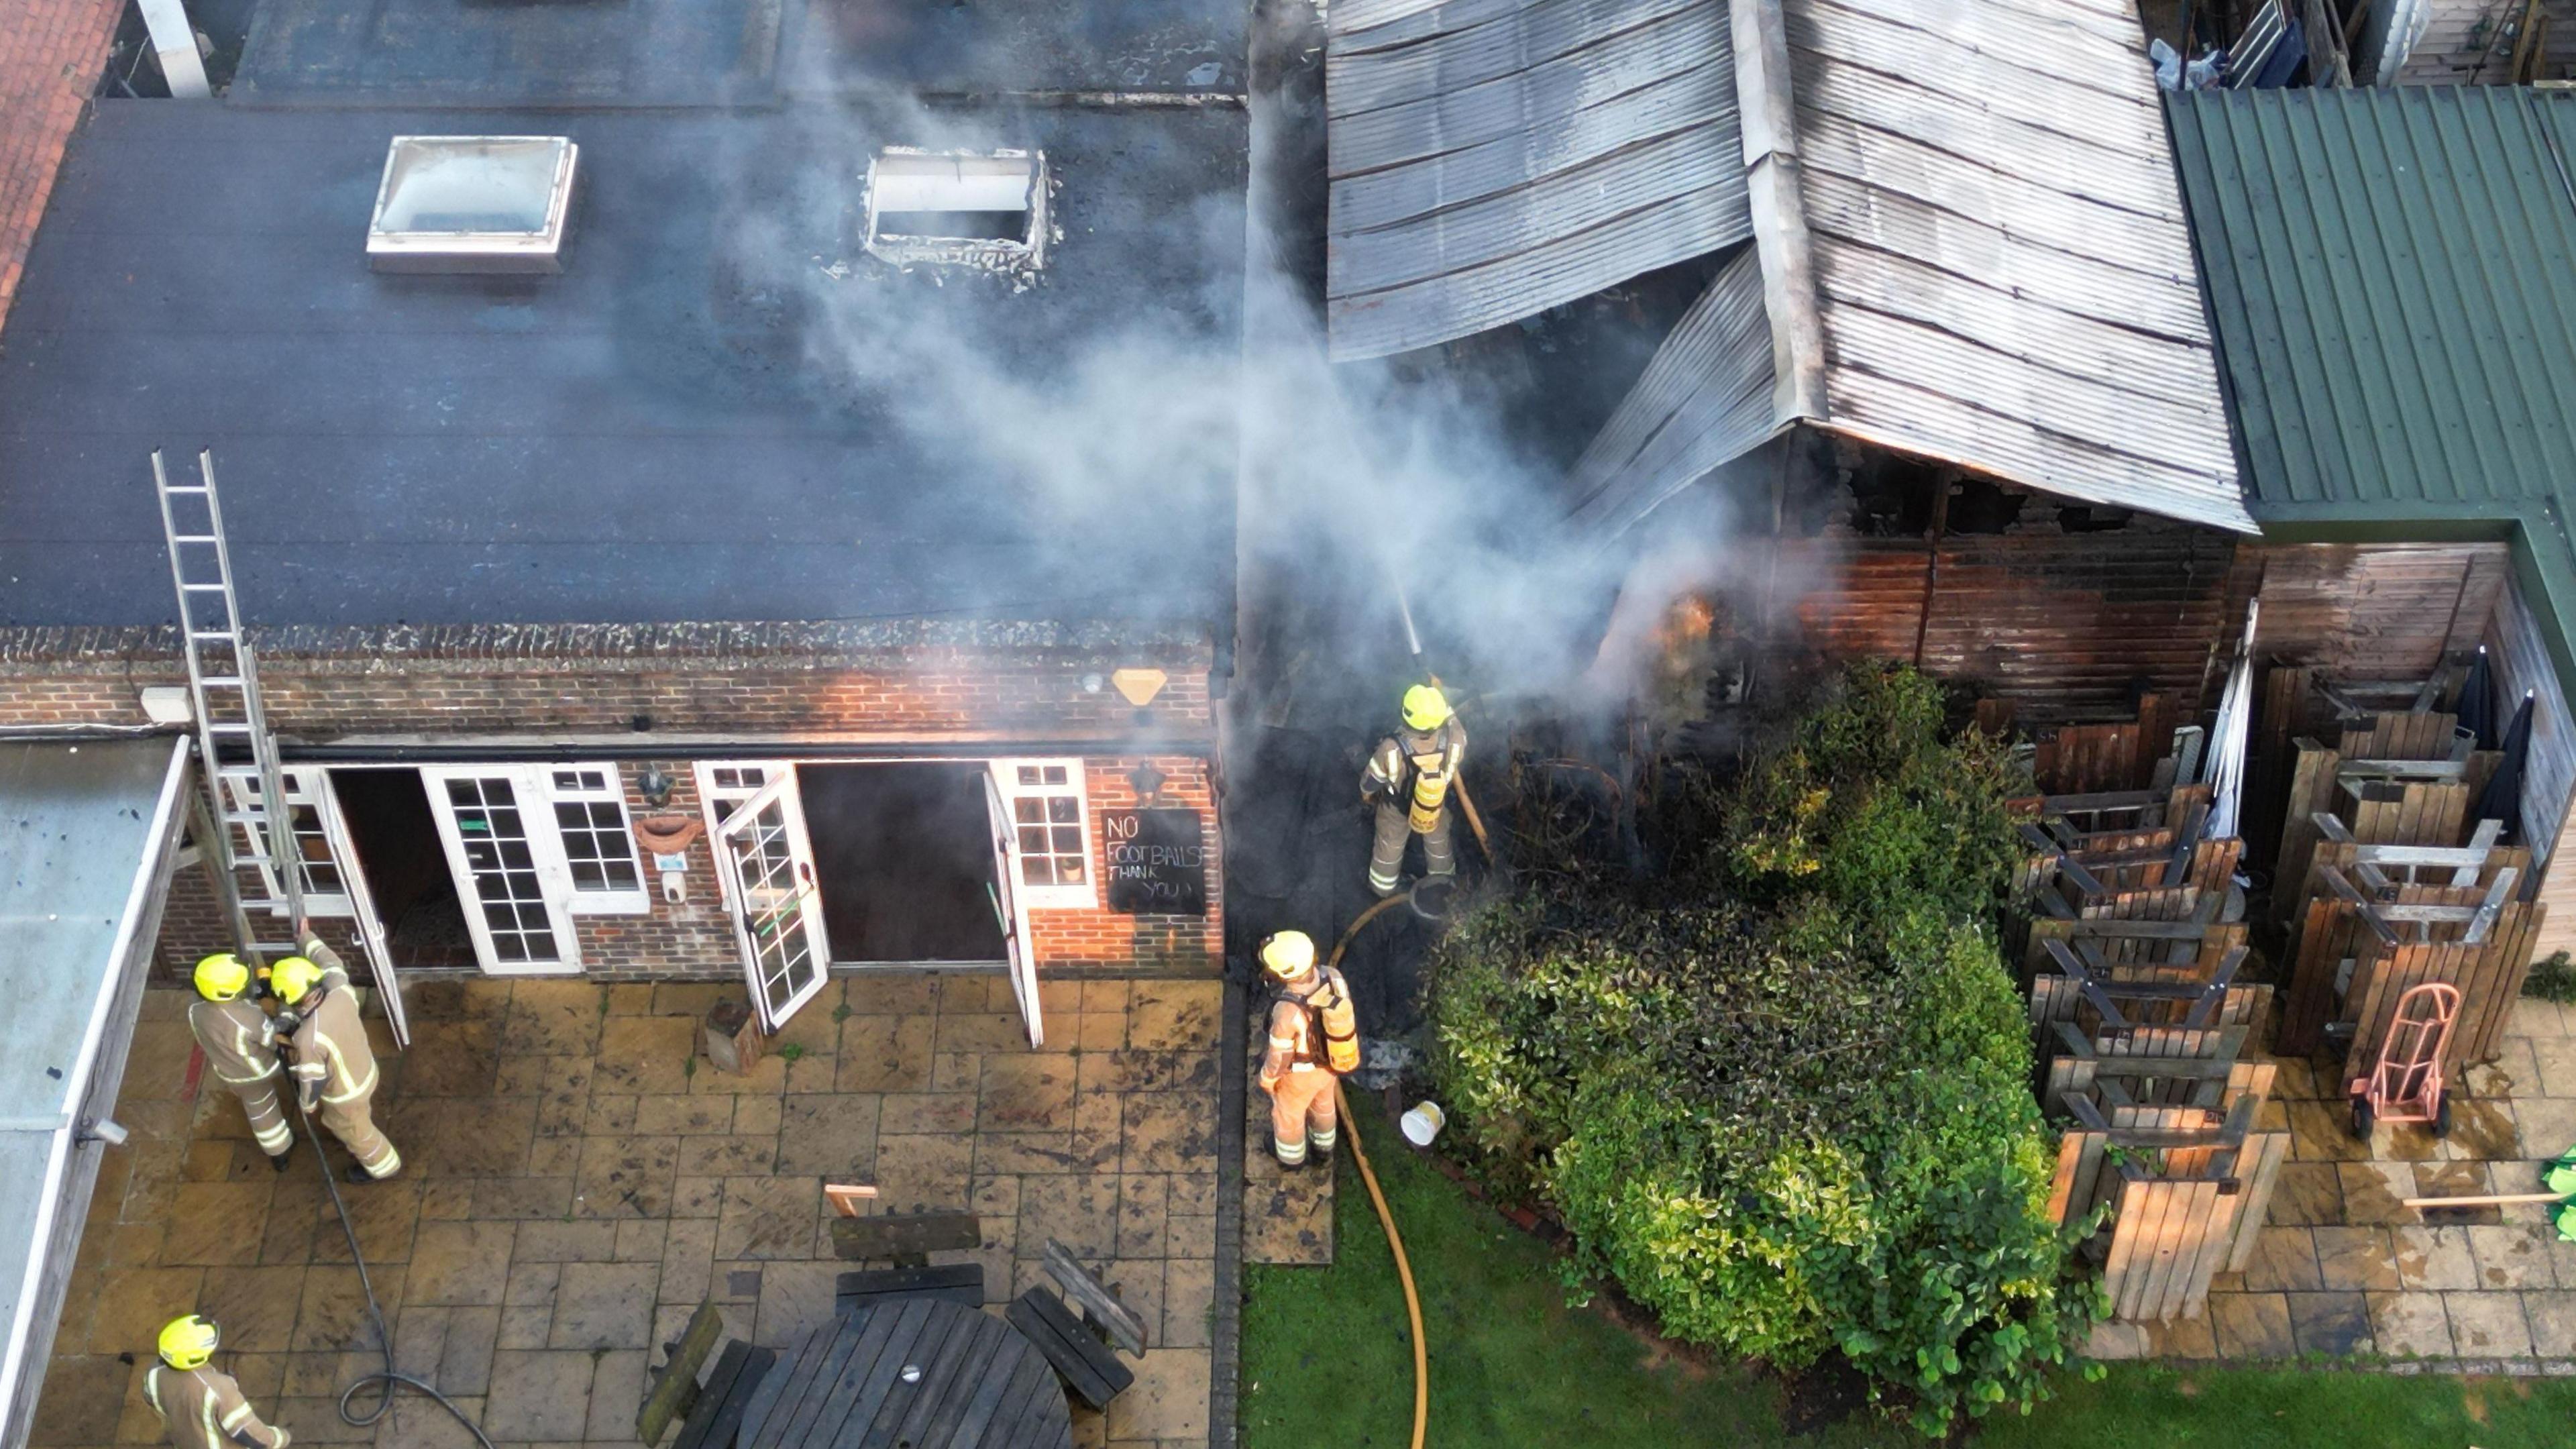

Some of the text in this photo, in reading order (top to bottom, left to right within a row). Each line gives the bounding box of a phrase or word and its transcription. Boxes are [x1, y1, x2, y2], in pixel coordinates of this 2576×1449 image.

[1108, 816, 1138, 838] NO
[1107, 841, 1203, 867] FOOTBALLS
[1107, 865, 1159, 881] THANK
